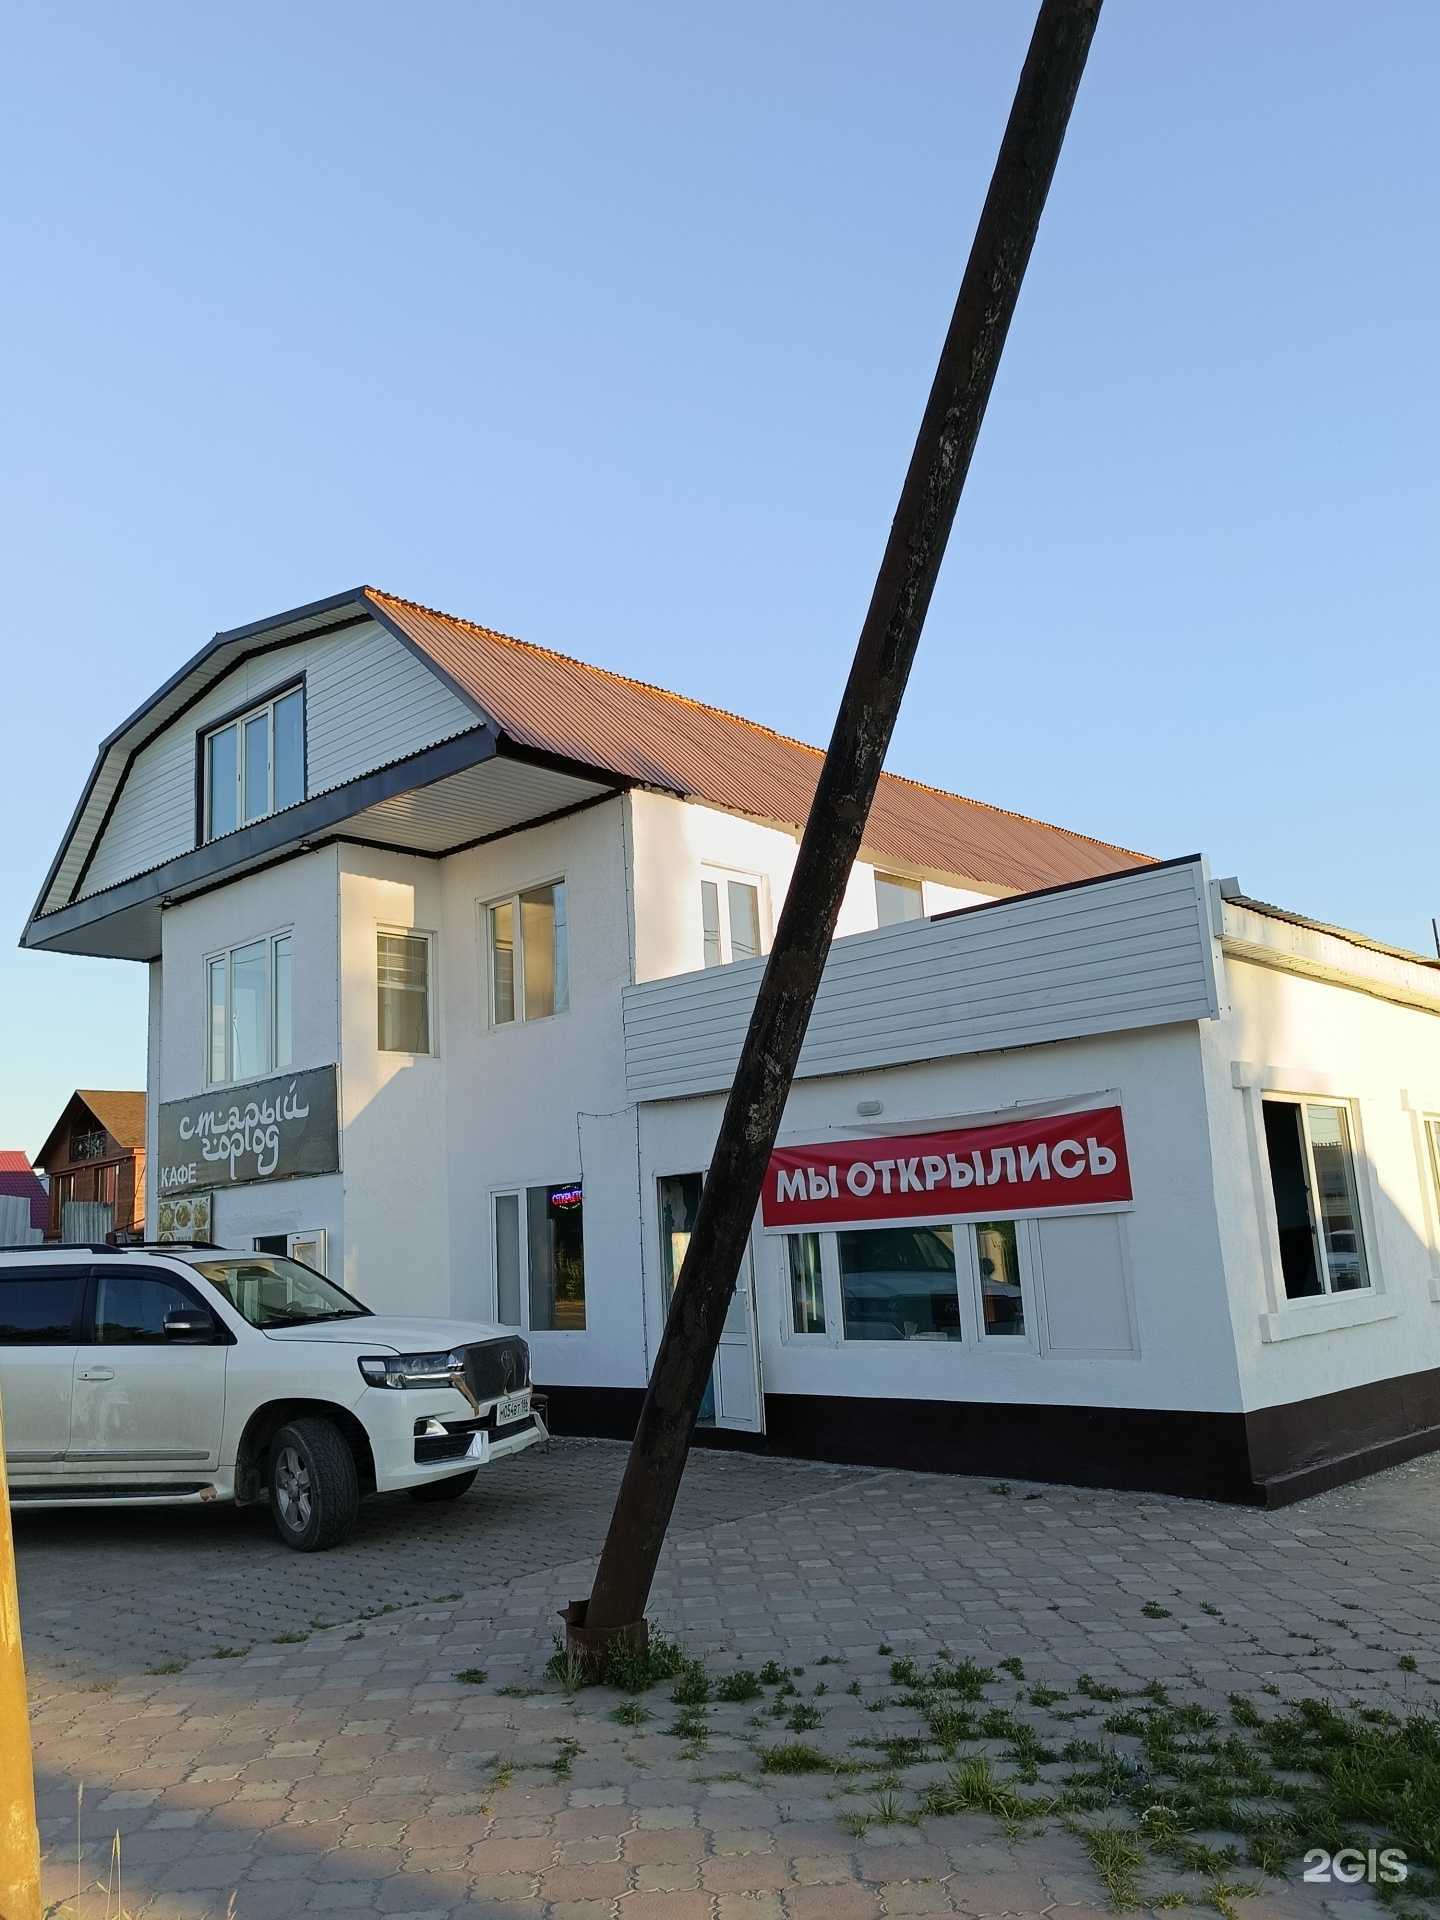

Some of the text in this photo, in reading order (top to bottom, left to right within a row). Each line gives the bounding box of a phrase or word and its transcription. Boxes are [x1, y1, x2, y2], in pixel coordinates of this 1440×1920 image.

[161, 1162, 197, 1188] КАФЕ
[776, 1137, 1117, 1203] МЫ ОТКРЫЛИСЬ
